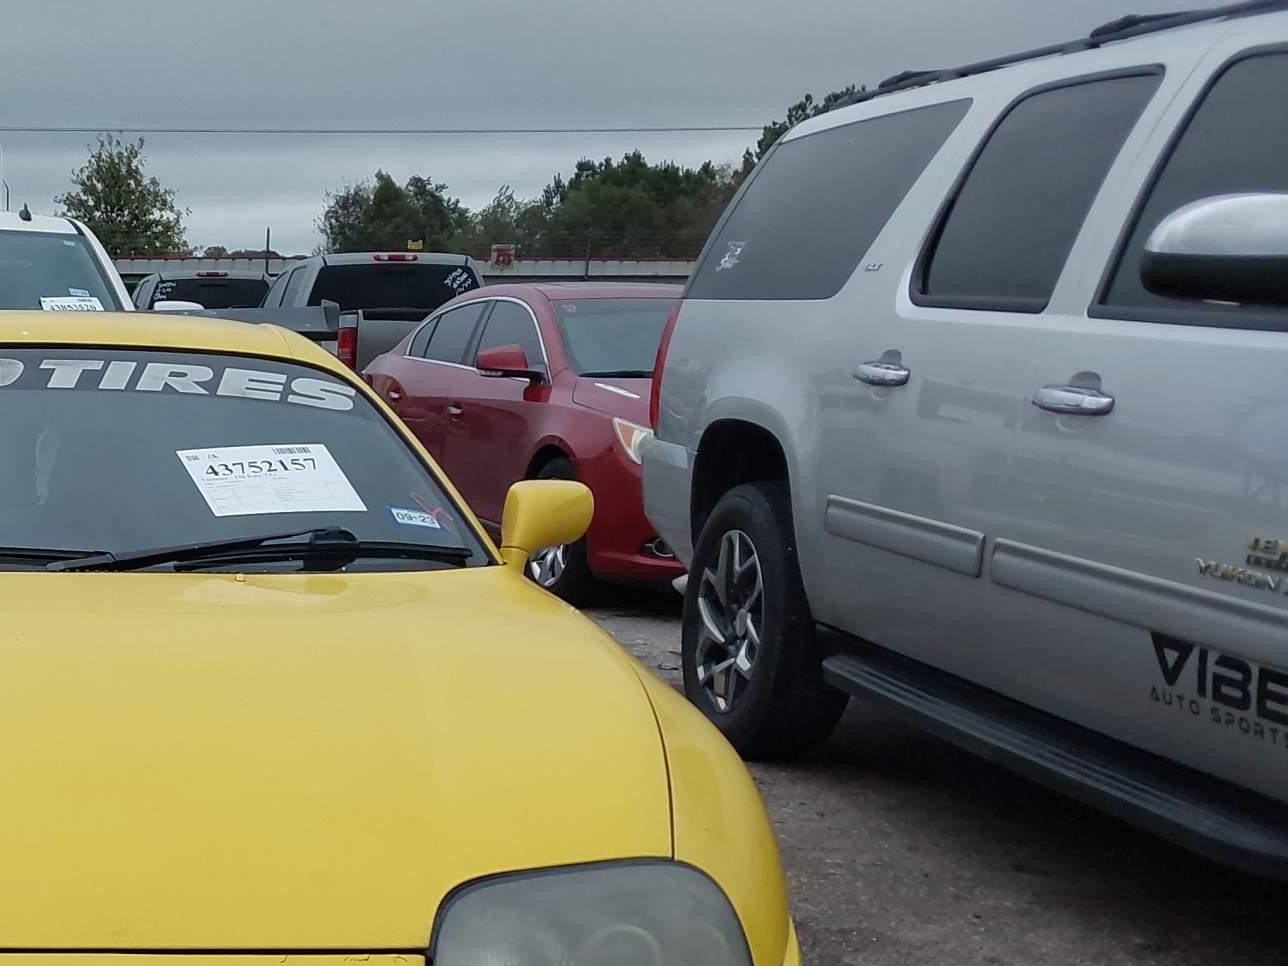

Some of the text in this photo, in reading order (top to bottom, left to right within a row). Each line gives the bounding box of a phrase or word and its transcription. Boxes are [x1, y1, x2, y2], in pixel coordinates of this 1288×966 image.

[39, 359, 358, 412] TIRES
[205, 457, 317, 477] 43752157
[1150, 631, 1288, 726] VIBE
[1150, 685, 1201, 716] AUTO
